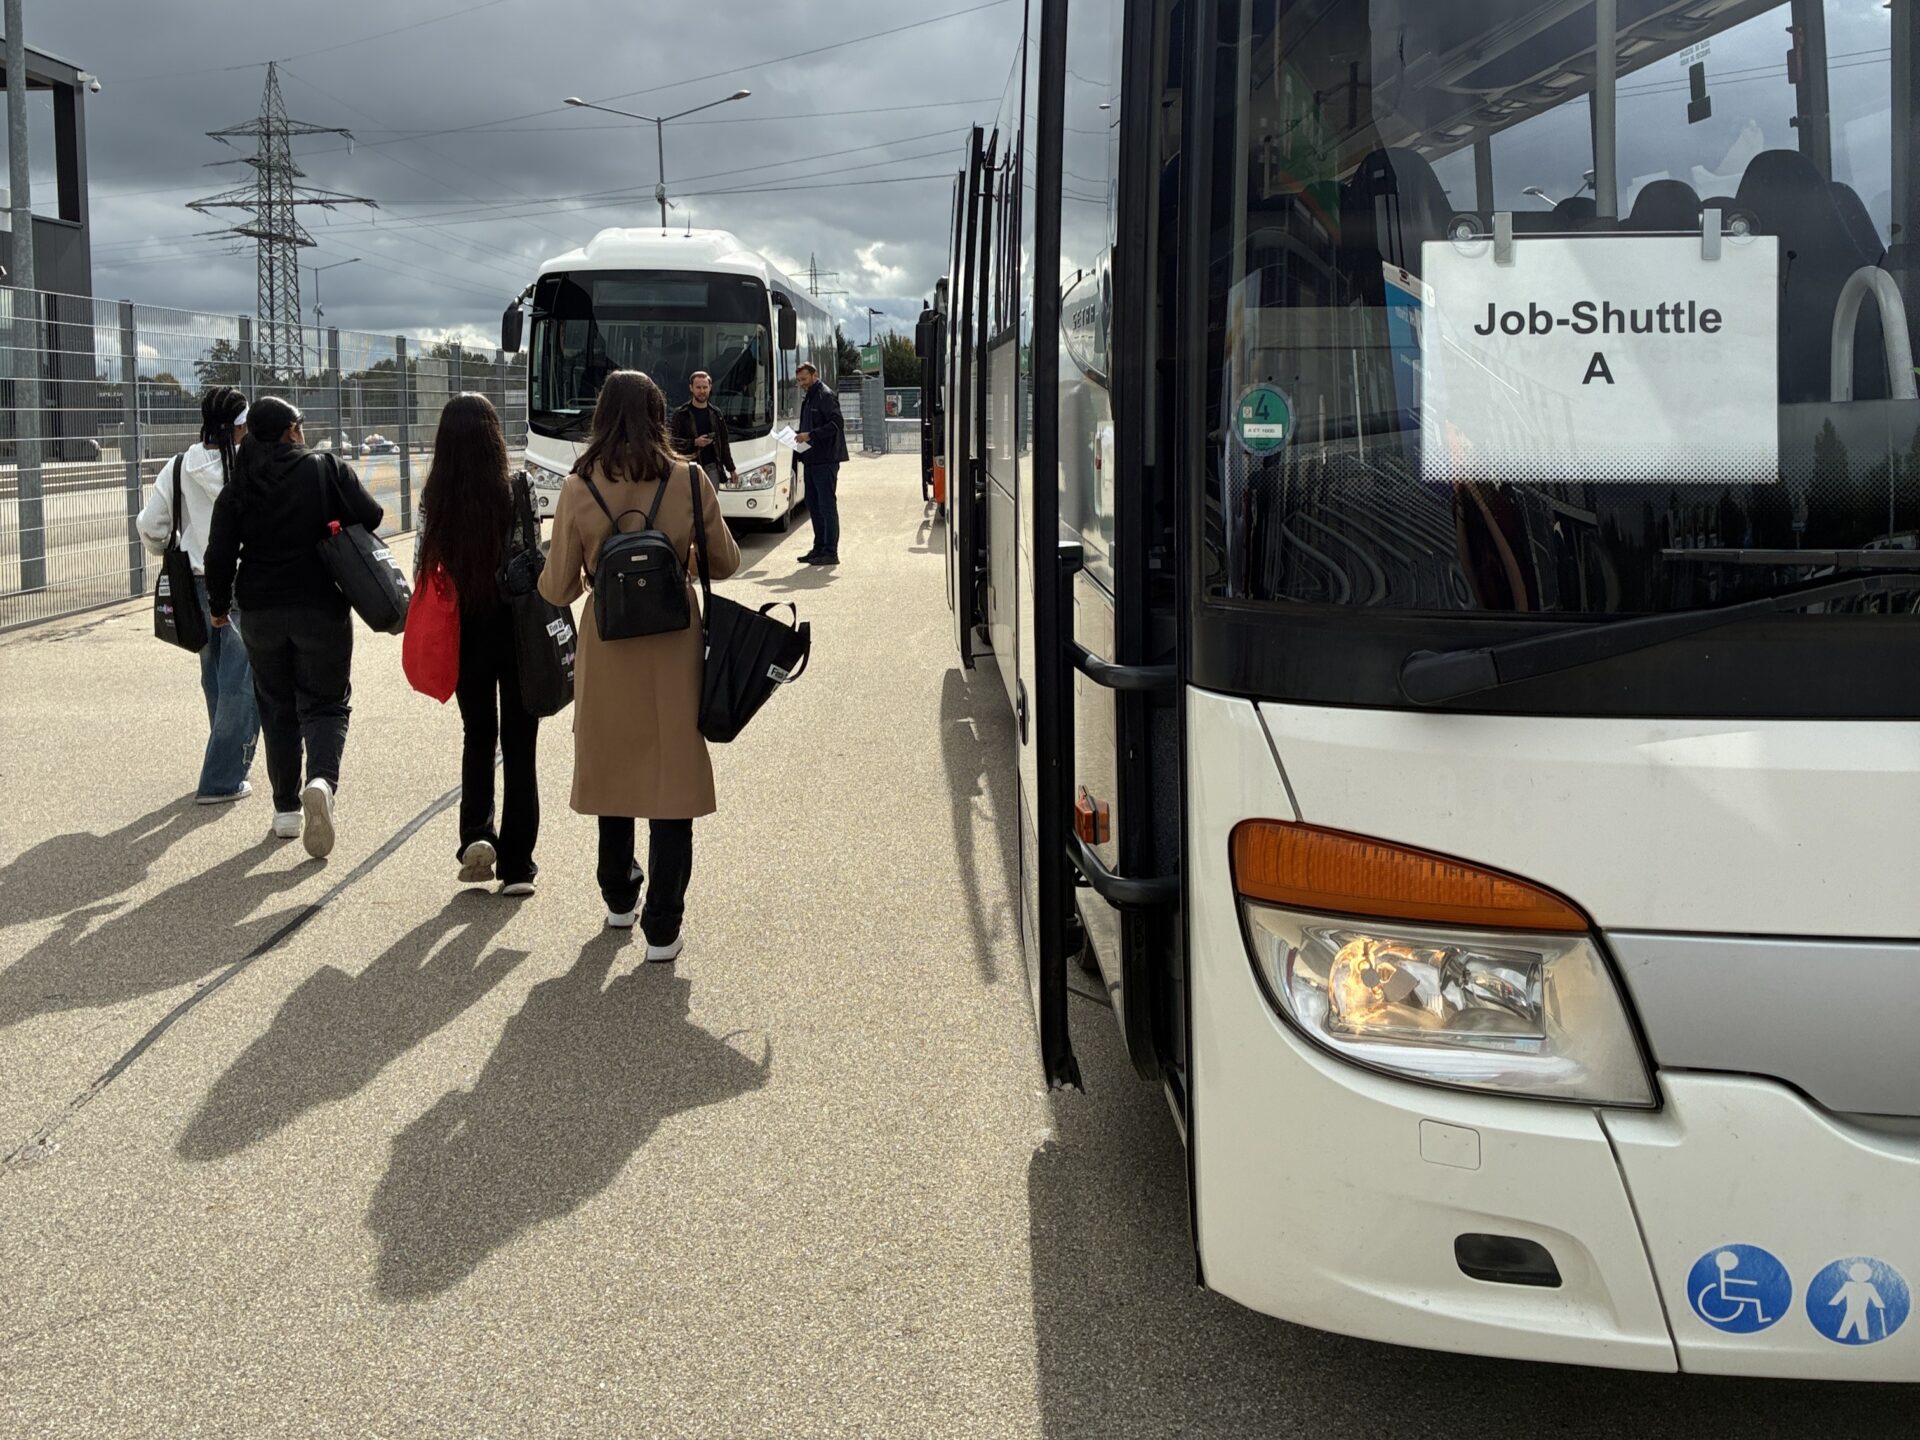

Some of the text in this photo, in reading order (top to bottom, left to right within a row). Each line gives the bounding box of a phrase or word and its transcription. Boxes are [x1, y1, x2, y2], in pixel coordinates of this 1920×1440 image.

[1474, 301, 1722, 336] Job-Shuttle
[1582, 352, 1615, 385] A
[1255, 393, 1270, 421] 4
